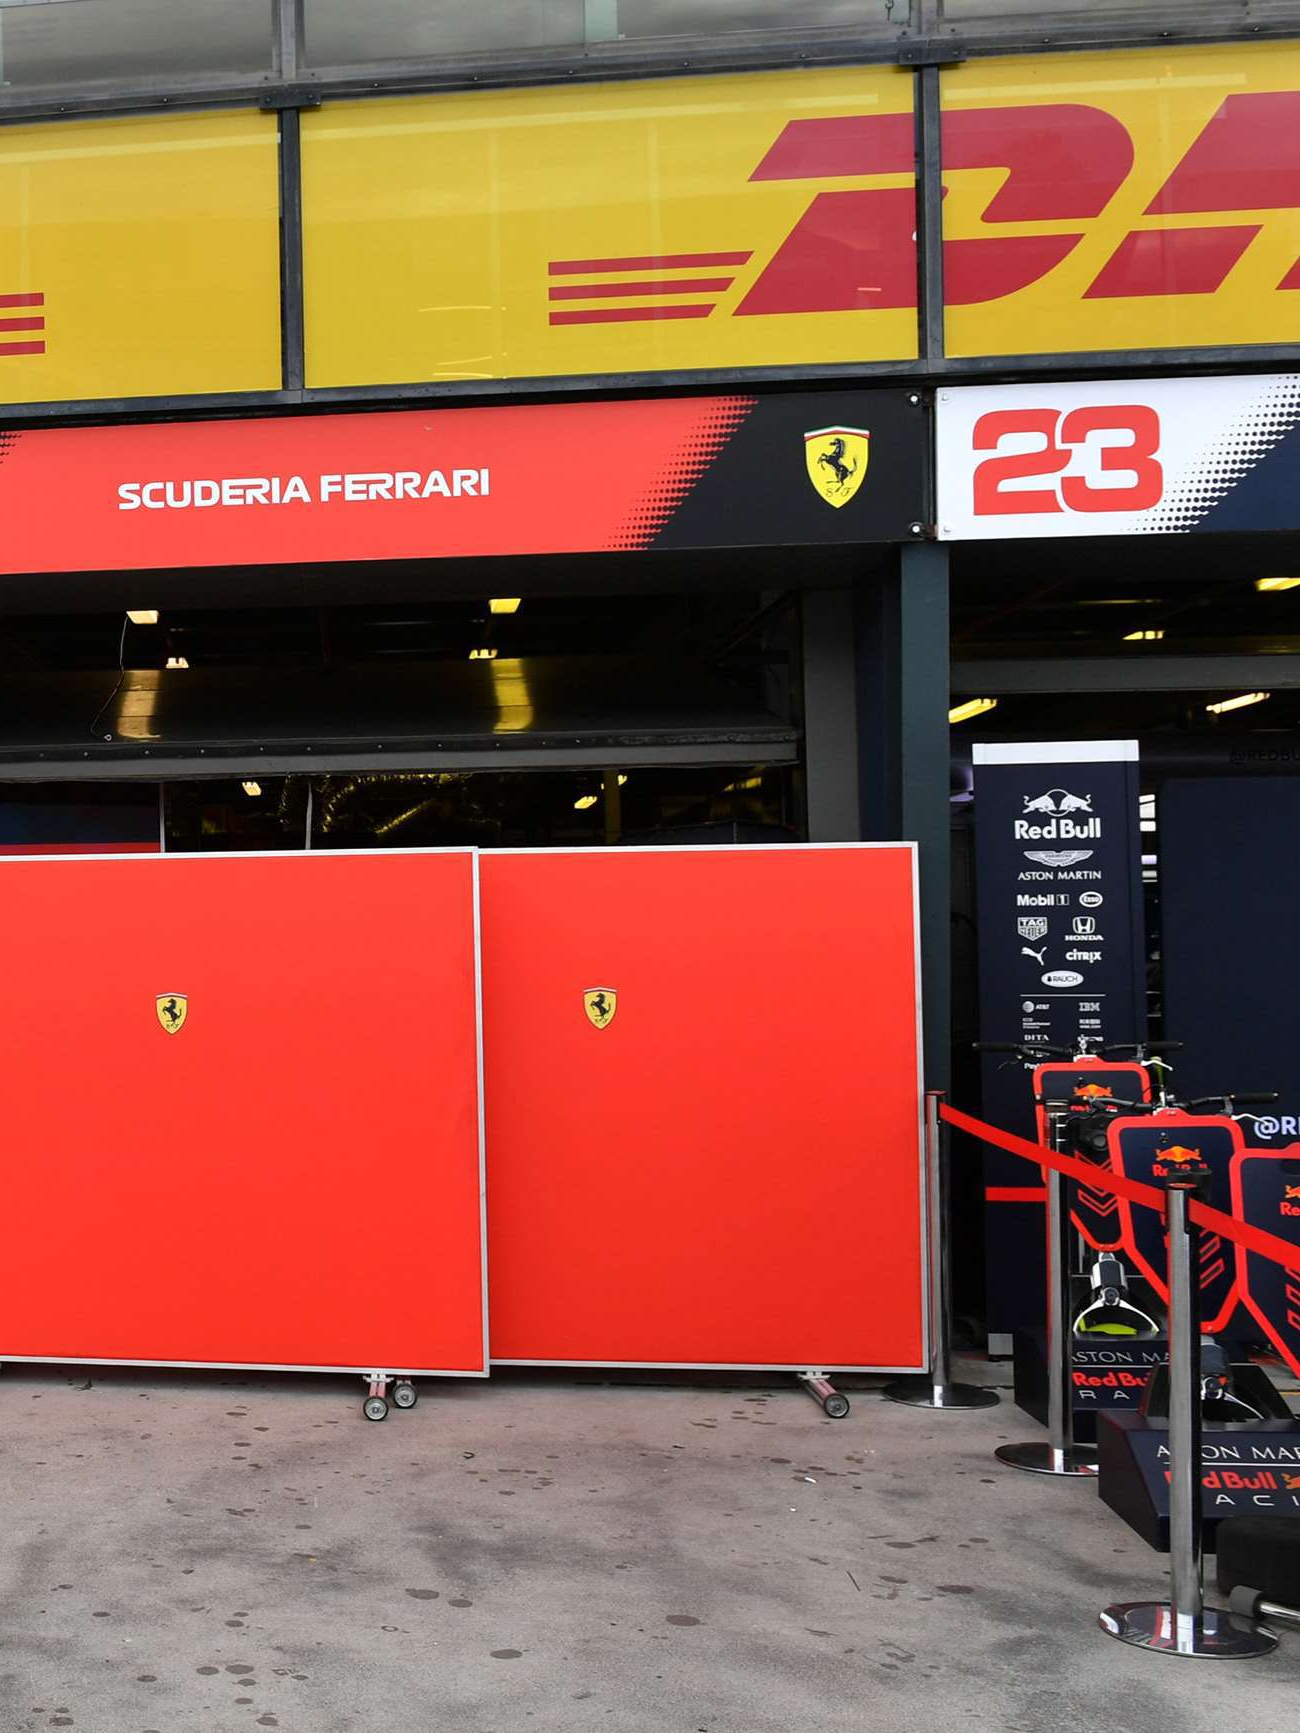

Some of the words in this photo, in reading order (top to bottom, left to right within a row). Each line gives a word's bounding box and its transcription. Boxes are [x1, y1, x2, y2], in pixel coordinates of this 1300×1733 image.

[972, 404, 1163, 516] 23
[118, 475, 311, 510] SCUDERIA
[320, 468, 490, 502] FERRARI
[1014, 818, 1057, 839] Red
[1059, 818, 1101, 839] Bull
[1018, 872, 1054, 881] ASTON
[1057, 870, 1102, 880] MARTIN
[1017, 894, 1055, 906] Mobil
[1021, 919, 1045, 927] TAG
[1079, 1002, 1100, 1012] IBM
[1072, 1371, 1118, 1387] Red
[1221, 1471, 1278, 1490] Bull
